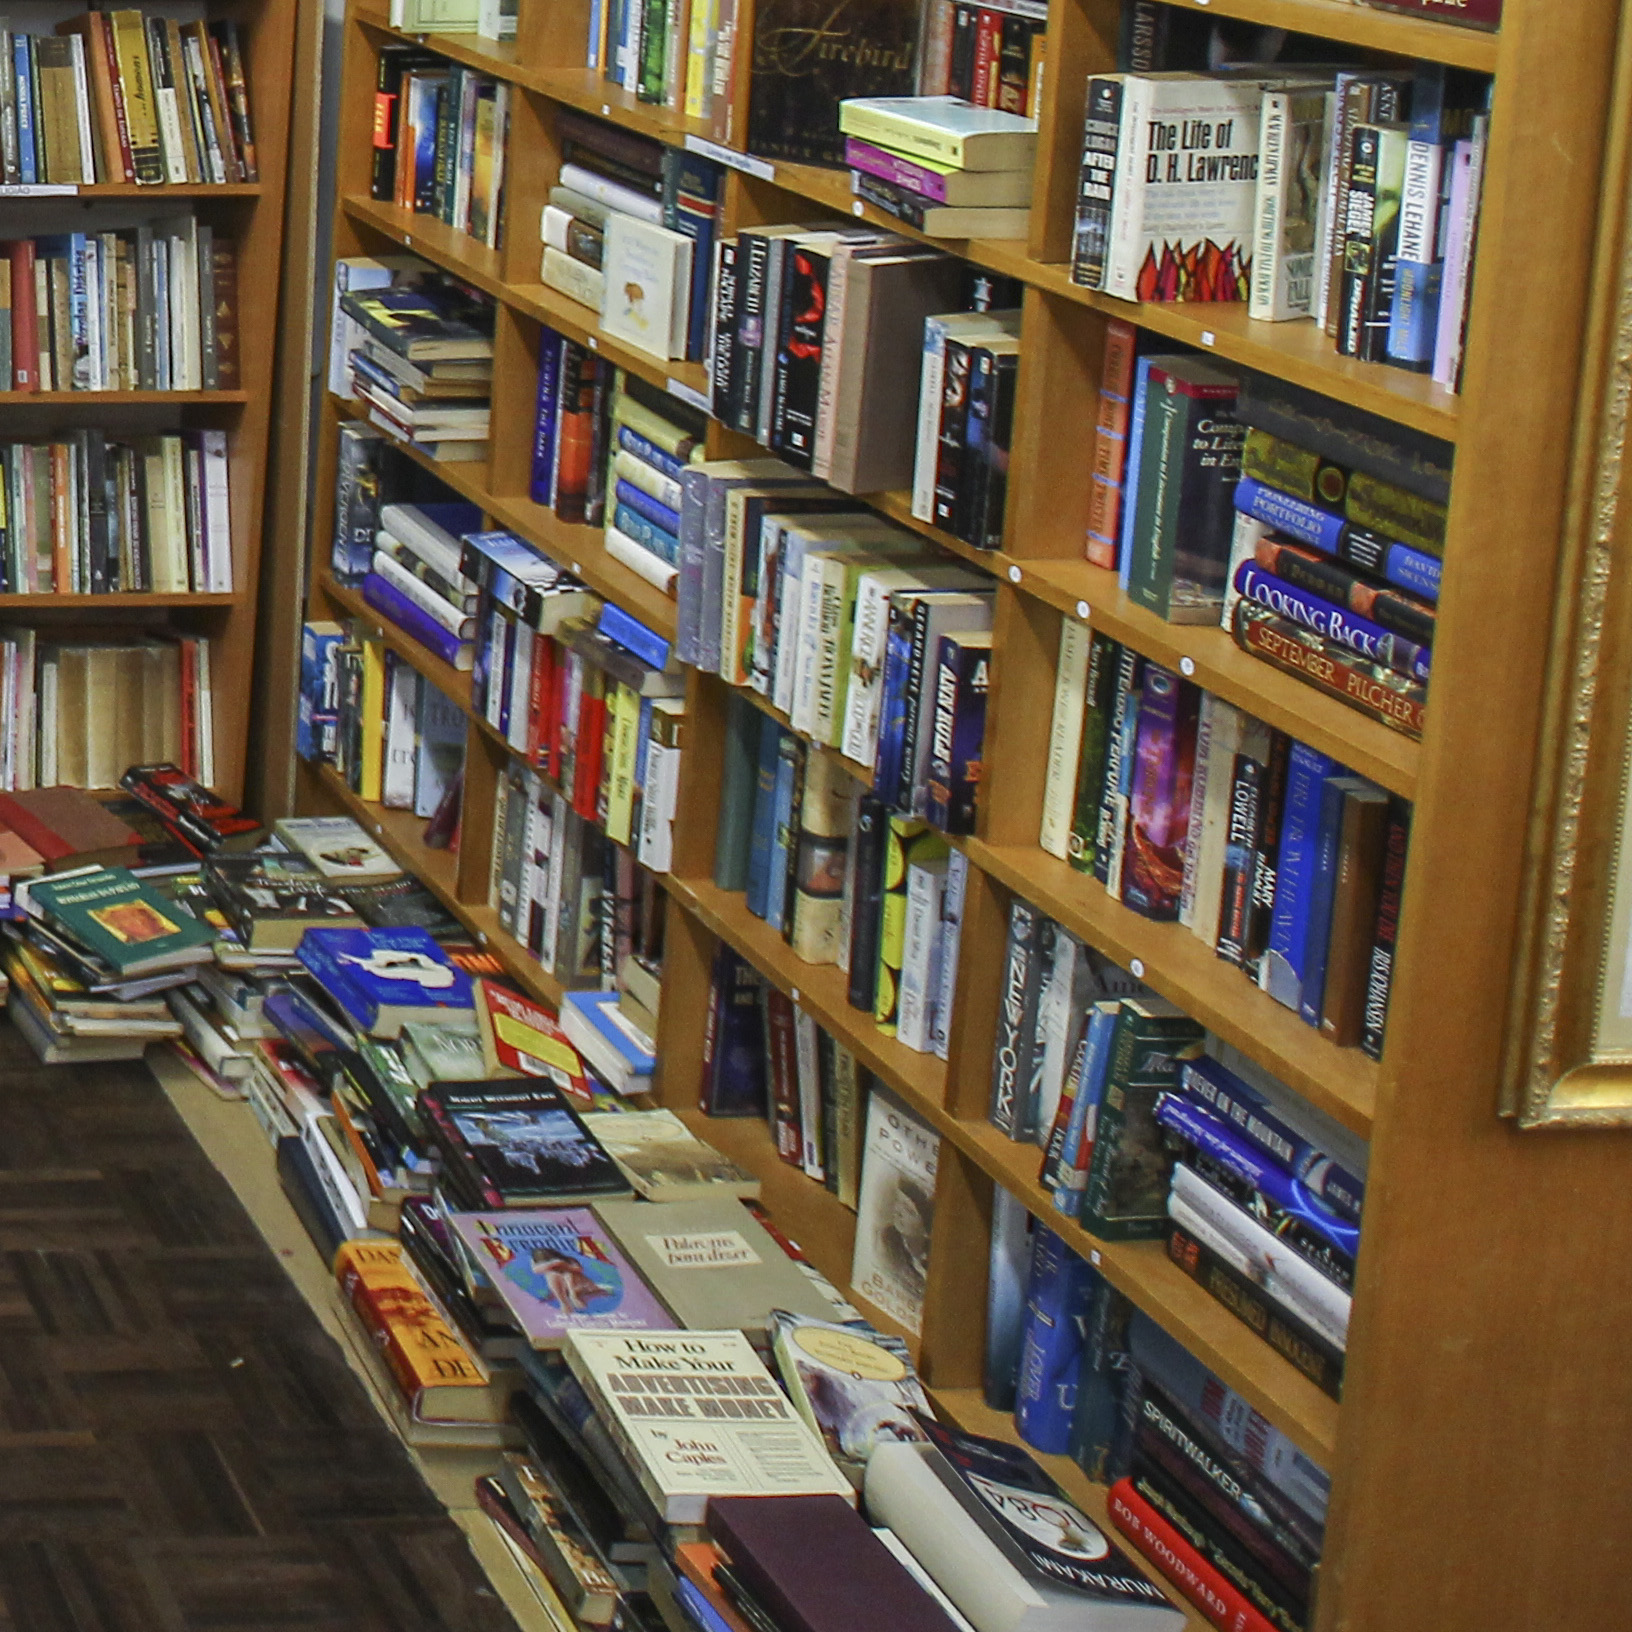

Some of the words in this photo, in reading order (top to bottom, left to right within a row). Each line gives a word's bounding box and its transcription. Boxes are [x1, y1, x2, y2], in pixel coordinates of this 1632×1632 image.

[1147, 119, 1176, 152] The
[1181, 119, 1212, 150] Life
[1216, 118, 1234, 149] of
[1082, 150, 1116, 169] AFTER
[1088, 168, 1111, 184] THE
[1145, 153, 1161, 184] D.
[1165, 154, 1183, 183] H.
[1410, 140, 1431, 200] DENNIS
[1082, 181, 1112, 201] RAIN
[1346, 187, 1367, 236] SIEGEL
[1359, 191, 1377, 238] JAMES
[1399, 201, 1425, 262] LEHANE
[1252, 496, 1324, 535] PORTFOLIO
[1242, 570, 1328, 635] LOOKING
[1328, 611, 1378, 657] BACK
[939, 663, 958, 699] ANN
[1258, 625, 1337, 681] SEPTEMBER
[1346, 672, 1415, 718] PILCHER
[934, 703, 955, 763] RULE
[1104, 742, 1124, 812] PERFUME
[1230, 779, 1245, 842] LOWELL
[1260, 866, 1277, 908] MARY
[476, 1218, 579, 1240] Innocent
[614, 1354, 672, 1372] Make
[675, 1355, 736, 1372] Your
[624, 1339, 671, 1356] How
[675, 1339, 706, 1356] to
[607, 1374, 779, 1396] ADVERTISING
[618, 1397, 695, 1419] MAKE
[699, 1397, 792, 1419] MONEY
[666, 1452, 727, 1467] Caples
[672, 1437, 718, 1453] John
[1143, 1399, 1242, 1499] SPIRITWALKER
[1032, 1551, 1167, 1602] MURAKAMI
[1112, 1497, 1141, 1529] BOB
[1143, 1528, 1228, 1617] WOODWARD
